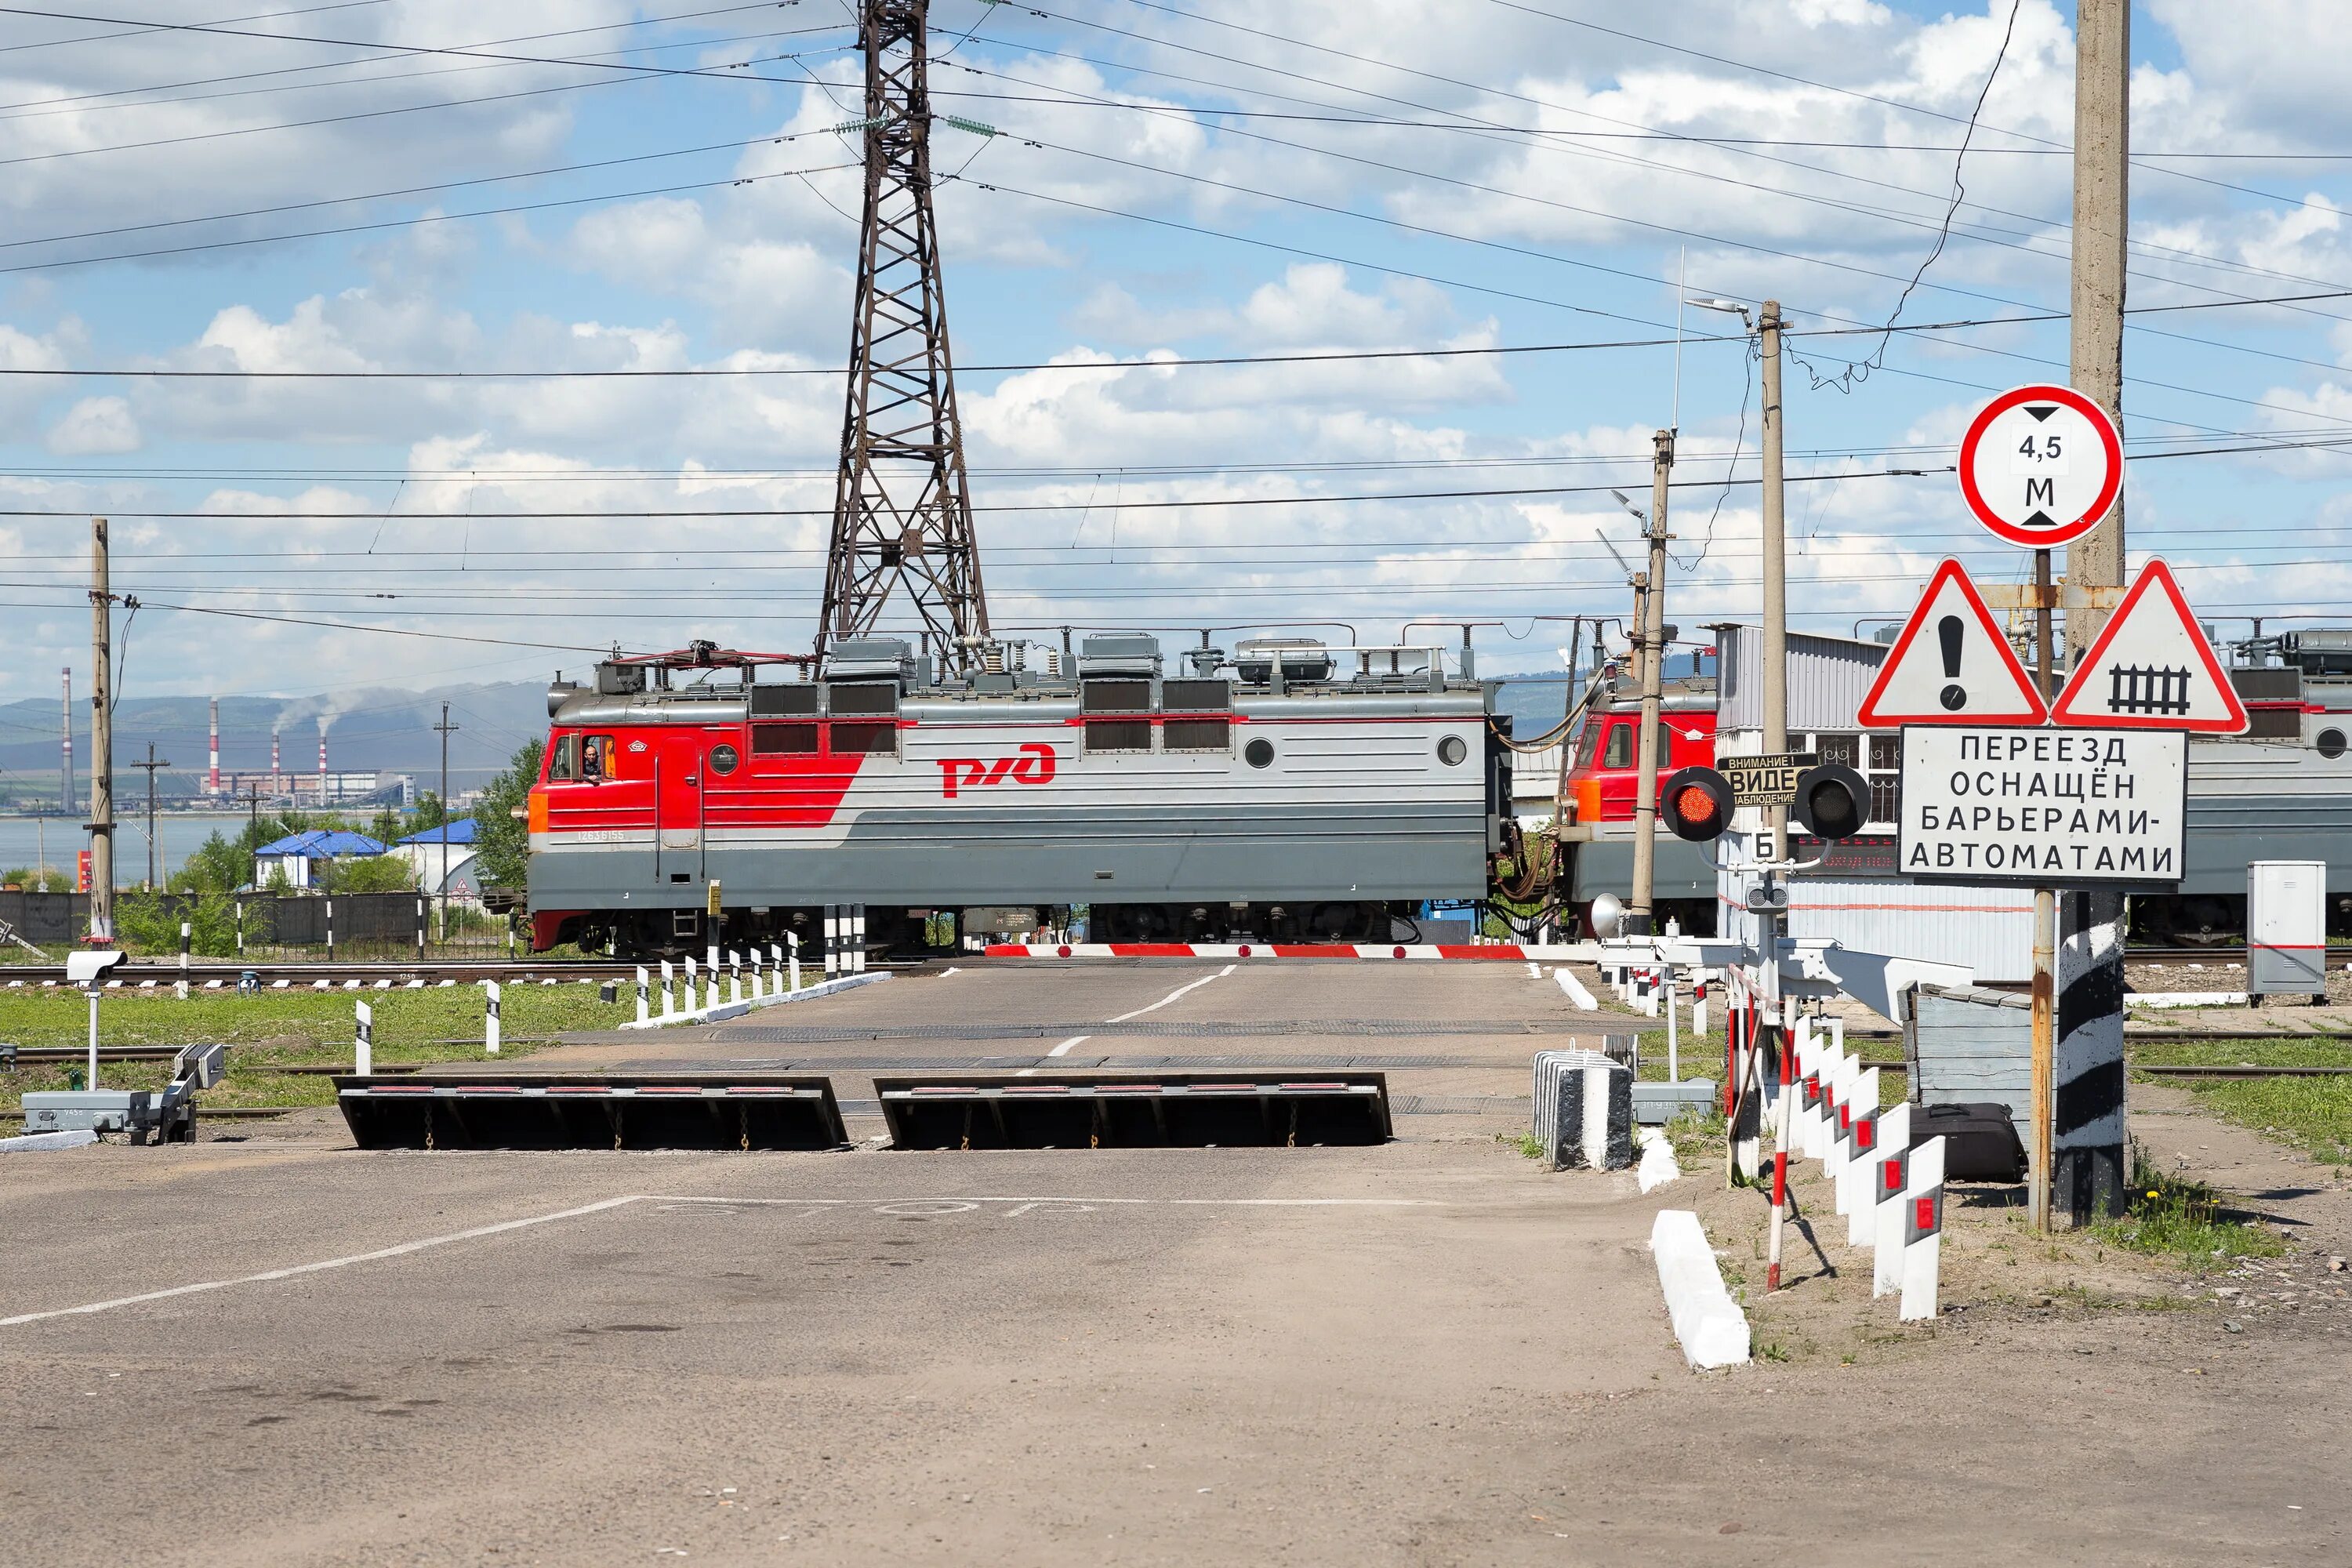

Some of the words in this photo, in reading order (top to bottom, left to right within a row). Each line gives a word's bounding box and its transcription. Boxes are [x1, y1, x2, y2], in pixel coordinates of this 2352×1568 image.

[2019, 435, 2062, 463] 4,5
[1729, 757, 1788, 769] ВНИМАНИЕ
[1960, 735, 2127, 768] ПЕРЕЕЗД
[1950, 768, 2135, 804] ОСНАЩЁН
[1922, 806, 2161, 836] БАРЬЕРАМИ-
[1755, 833, 1773, 858] Б
[1909, 843, 2173, 873] АВТОМАТАМИ
